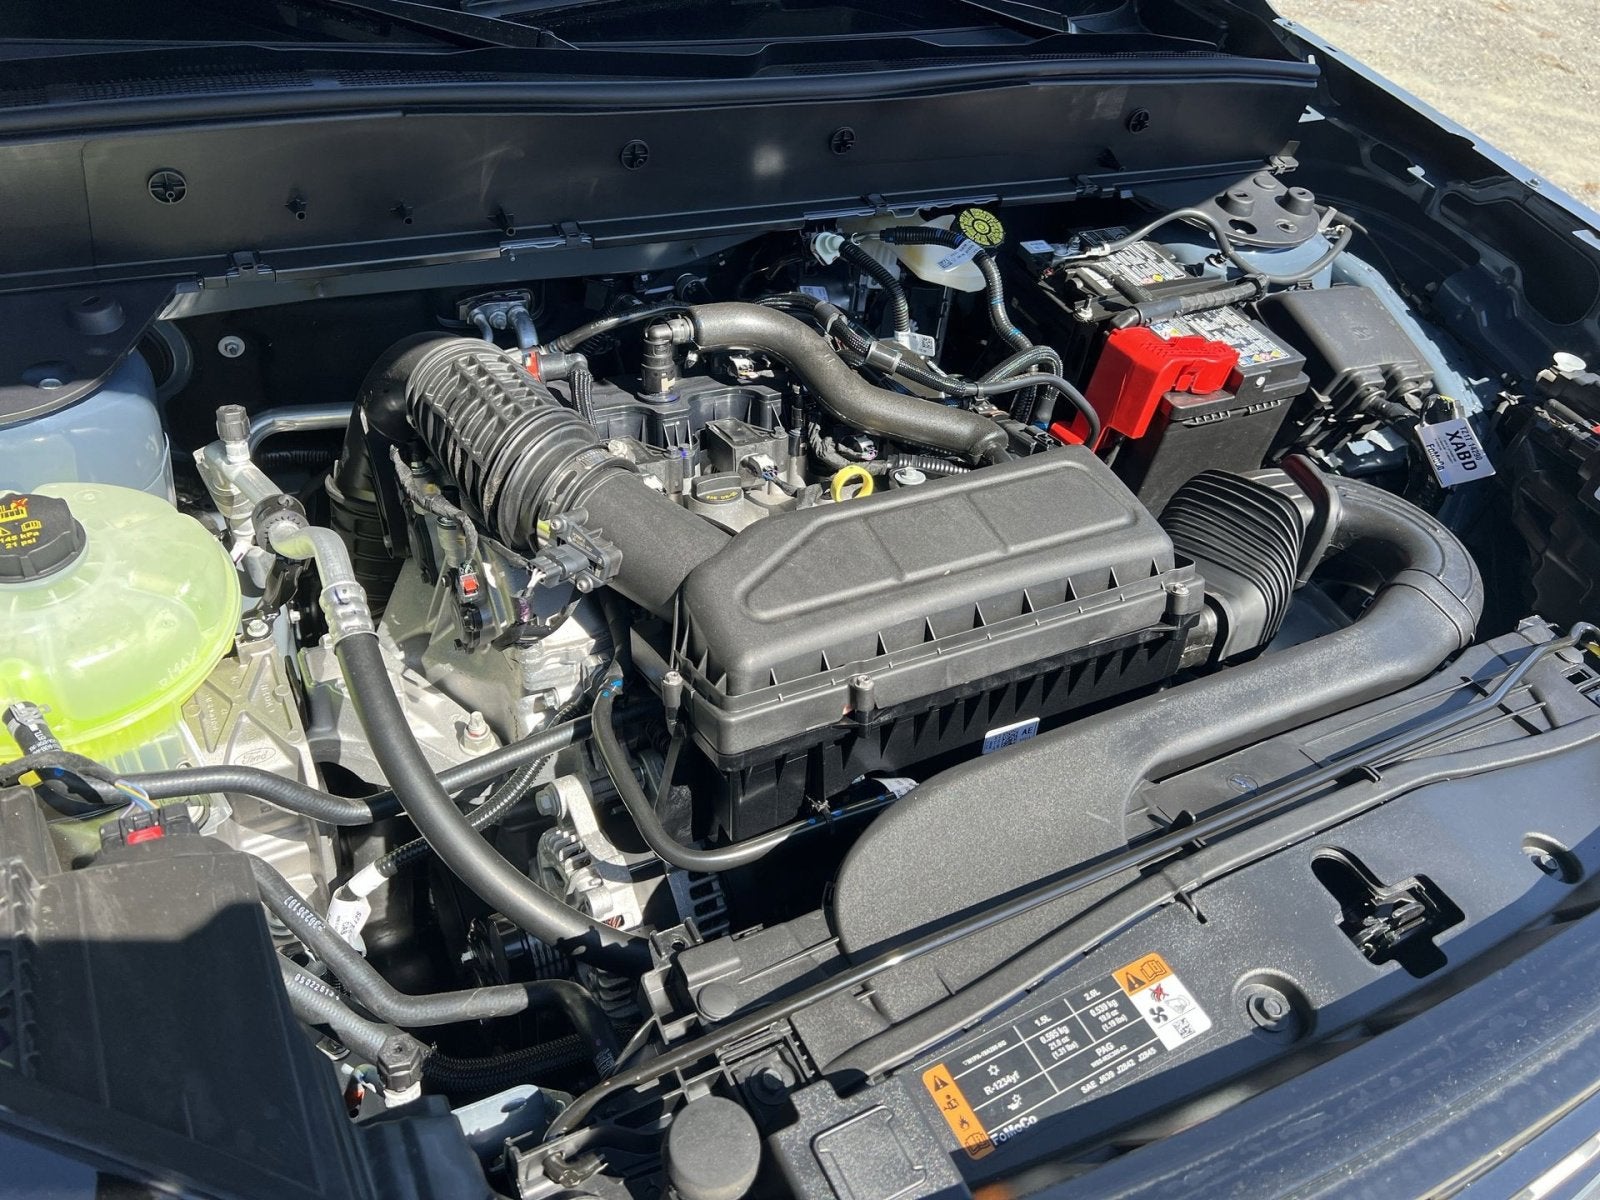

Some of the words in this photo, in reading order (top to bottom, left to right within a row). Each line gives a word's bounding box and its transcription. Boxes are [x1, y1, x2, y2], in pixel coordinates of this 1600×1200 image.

[1445, 430, 1478, 471] XABD
[20, 531, 40, 540] kPa
[5, 541, 18, 549] 21
[20, 537, 37, 547] psi
[1083, 988, 1101, 1001] 2.0L
[1107, 999, 1119, 1009] kg
[1034, 1014, 1052, 1027] 1.5L
[1115, 1014, 1128, 1026] lbs)
[1058, 1025, 1070, 1036] kg
[1065, 1041, 1079, 1053] lbs)
[1095, 1042, 1115, 1057] PAG
[983, 1070, 1020, 1096] R-1234yf
[1080, 1080, 1098, 1094] SAE
[1099, 1070, 1116, 1084] J639
[990, 1114, 1038, 1146] FoMoCo
